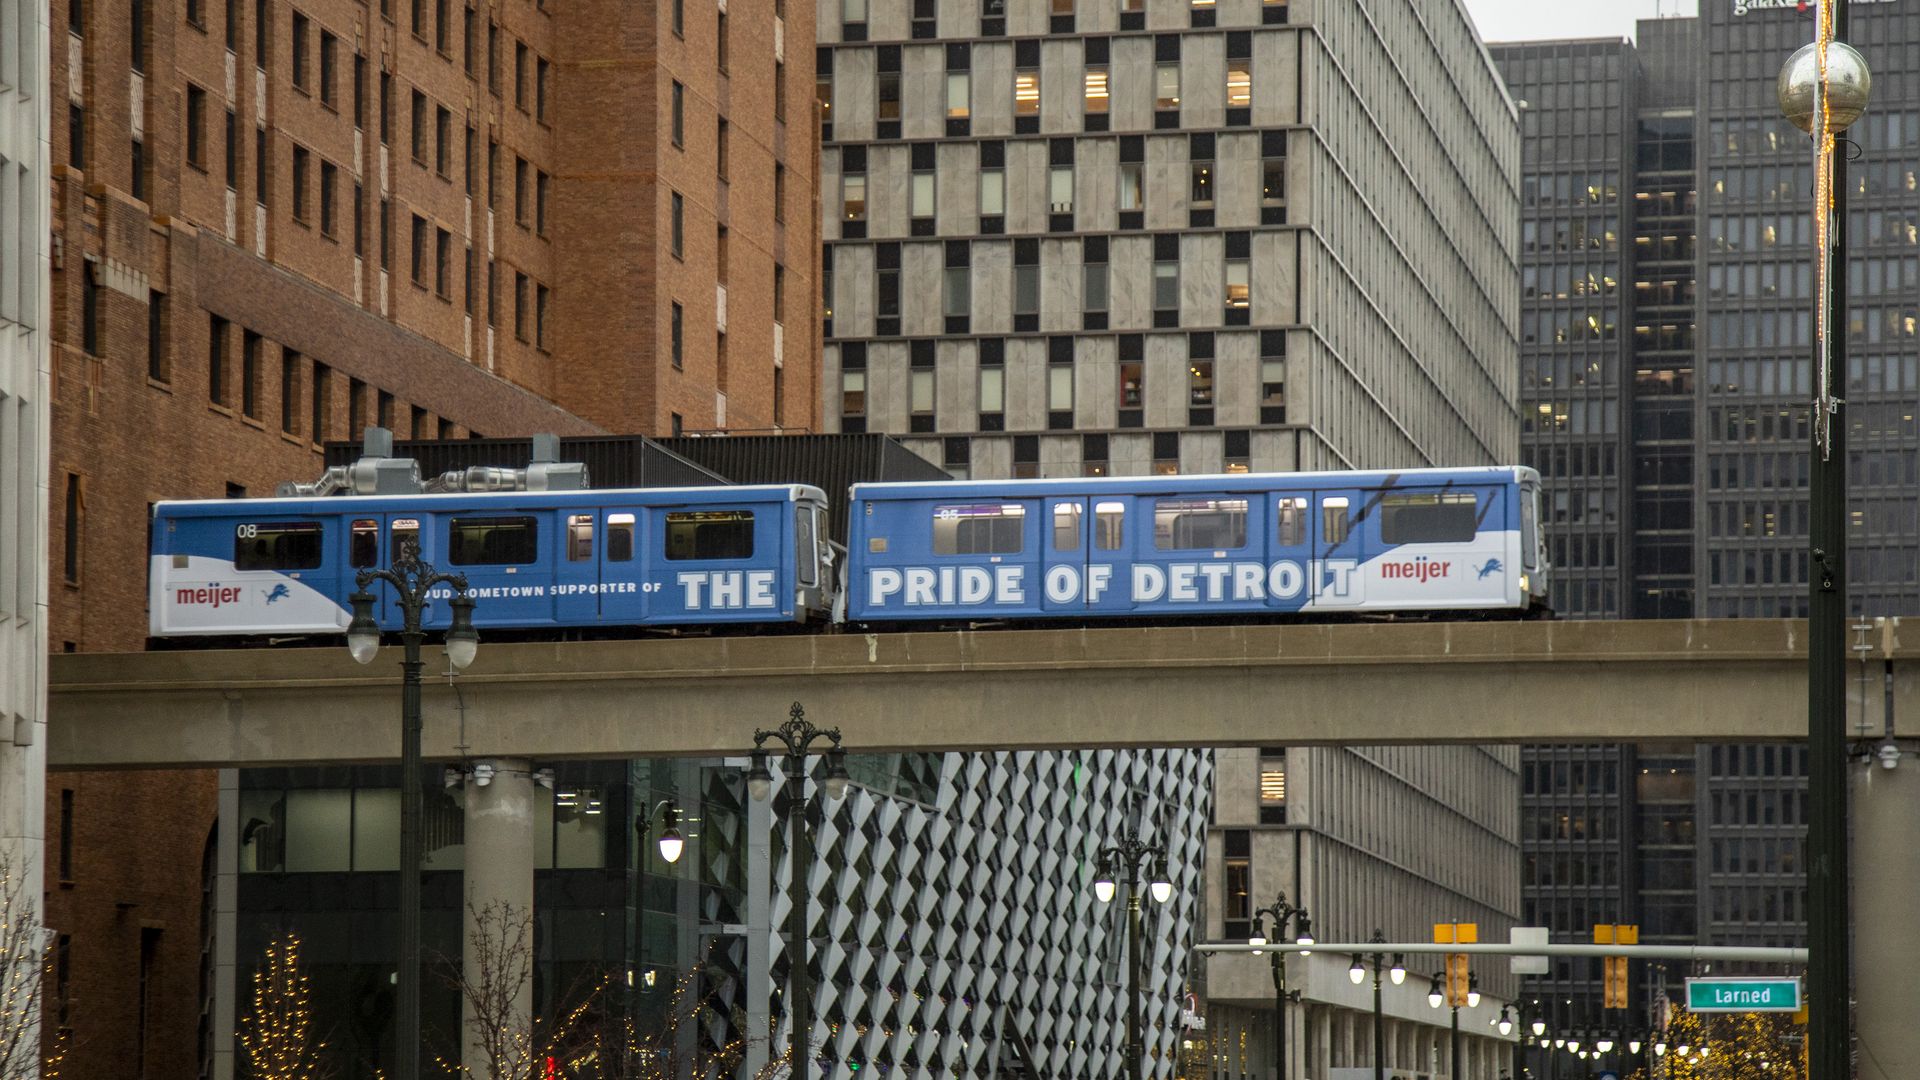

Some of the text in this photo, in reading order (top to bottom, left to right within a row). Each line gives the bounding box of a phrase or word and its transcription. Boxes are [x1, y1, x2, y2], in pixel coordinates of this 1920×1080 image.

[237, 524, 256, 538] 08
[869, 558, 1358, 606] PRIDE OF DETROIT
[1382, 556, 1451, 583] meijer
[177, 582, 242, 608] meijer
[458, 586, 544, 598] OMETOWN
[550, 583, 636, 595] SUPPORTER
[642, 582, 662, 593] OF
[677, 570, 776, 610] THE
[1715, 988, 1771, 1003] Larned
